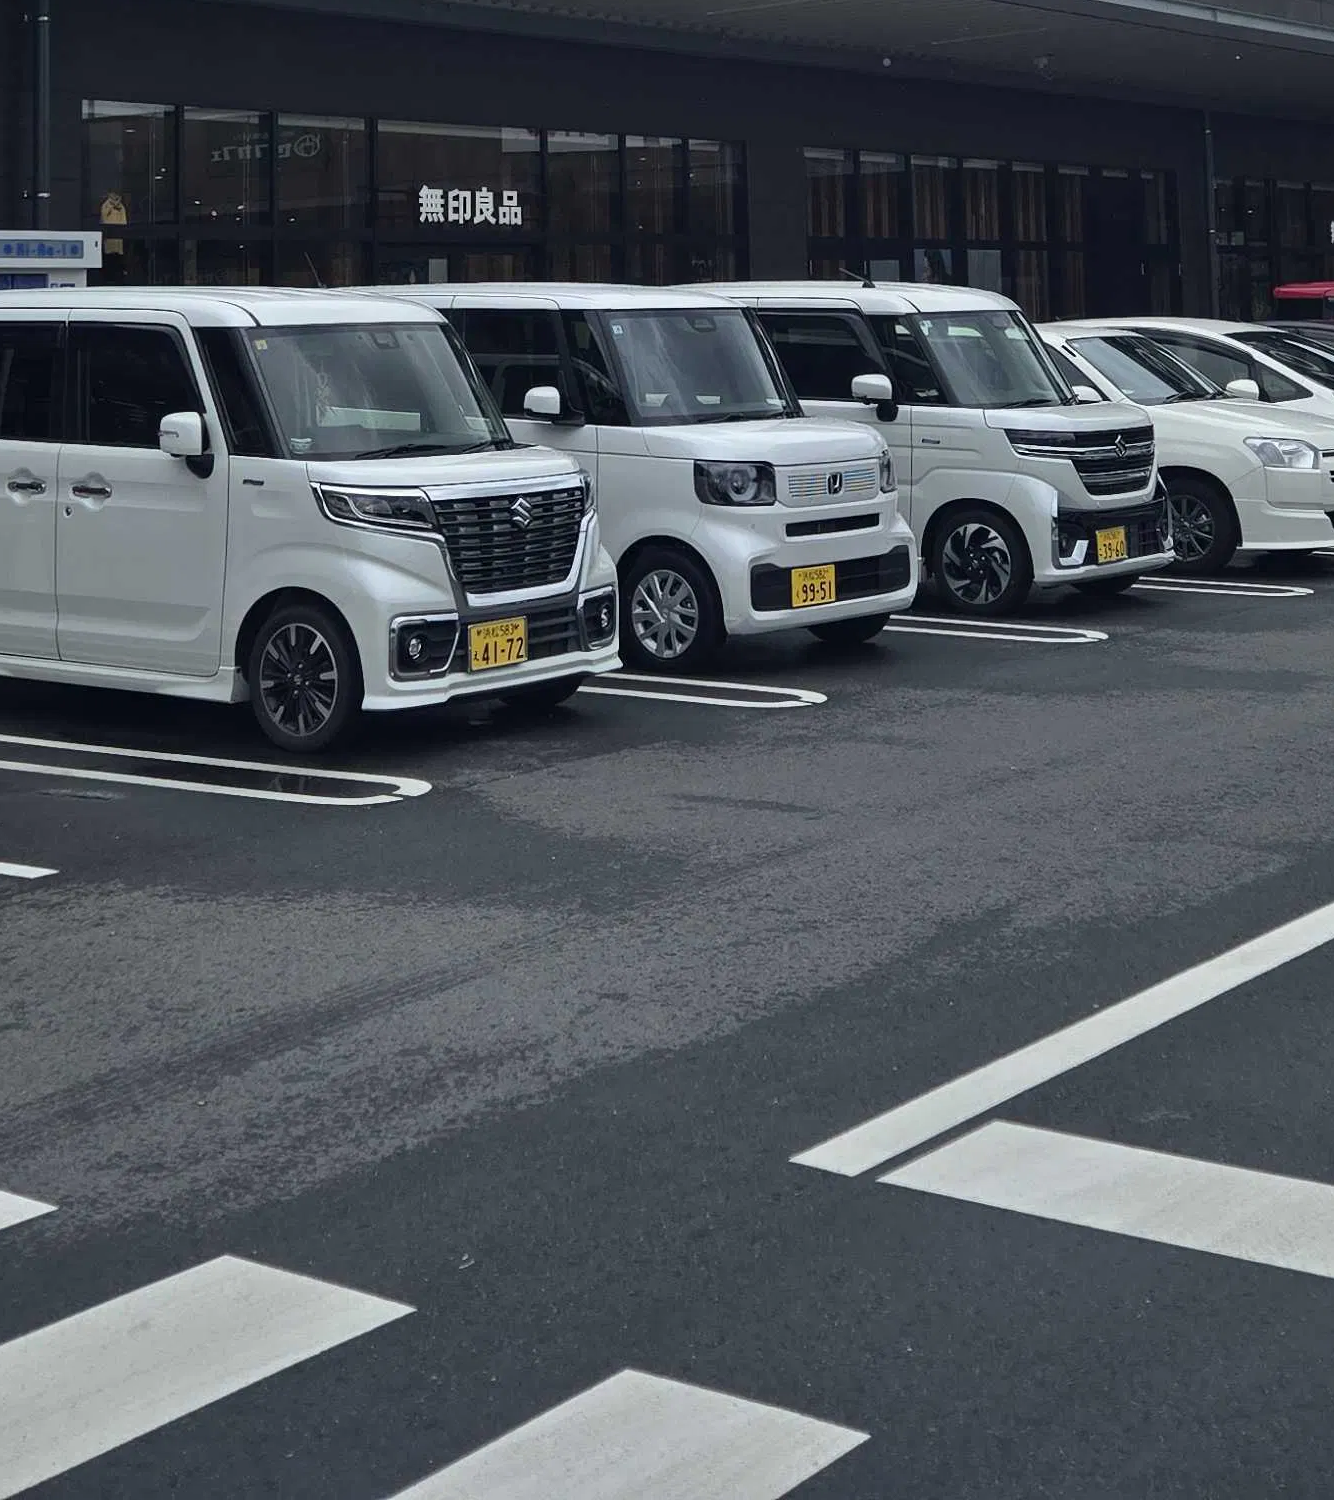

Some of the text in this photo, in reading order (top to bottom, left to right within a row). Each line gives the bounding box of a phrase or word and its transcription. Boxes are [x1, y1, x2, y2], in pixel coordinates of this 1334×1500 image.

[418, 185, 523, 227] 無印良品
[802, 579, 833, 603] 99-51
[481, 636, 525, 665] 41-72
